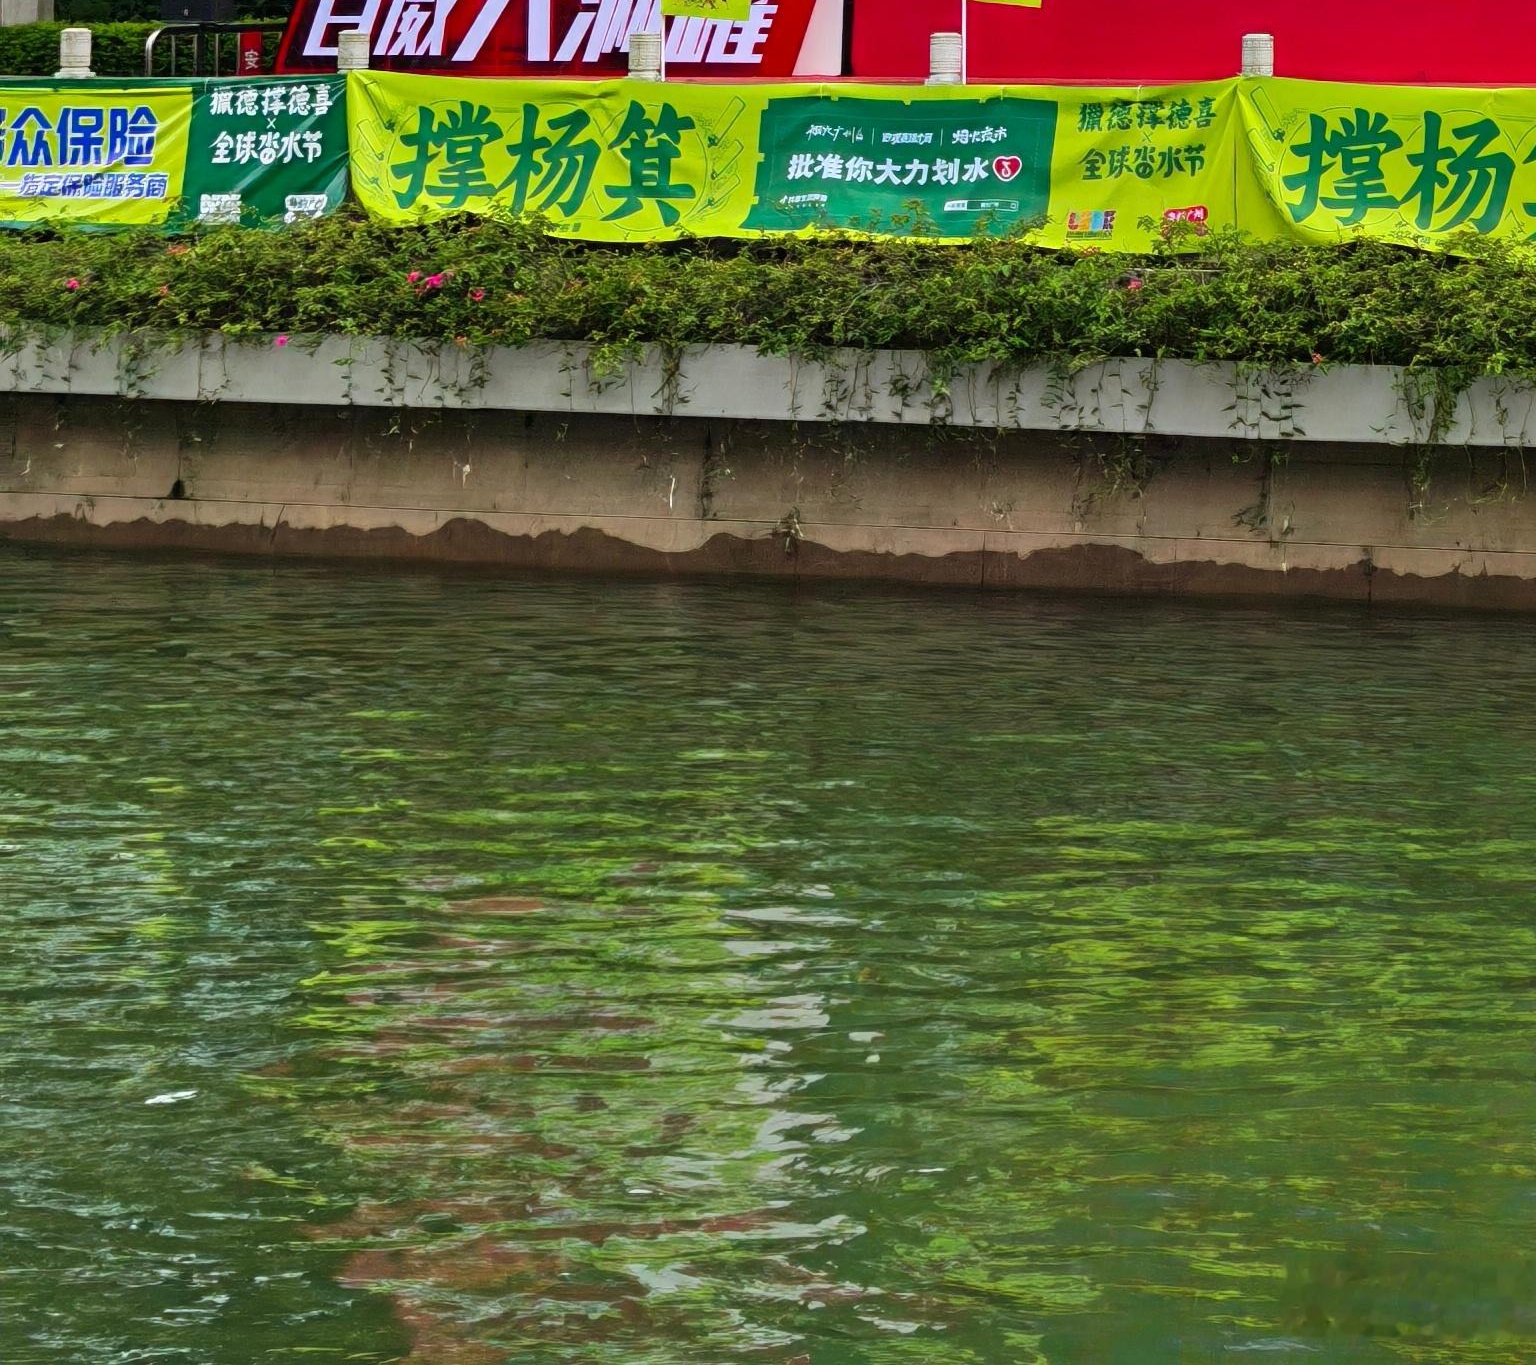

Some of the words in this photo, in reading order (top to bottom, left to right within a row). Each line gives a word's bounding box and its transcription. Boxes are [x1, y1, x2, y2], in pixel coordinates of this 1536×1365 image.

[0, 105, 158, 168] 众保险
[390, 100, 698, 227] 撑杨箕
[786, 153, 990, 186] 批准你大力划水
